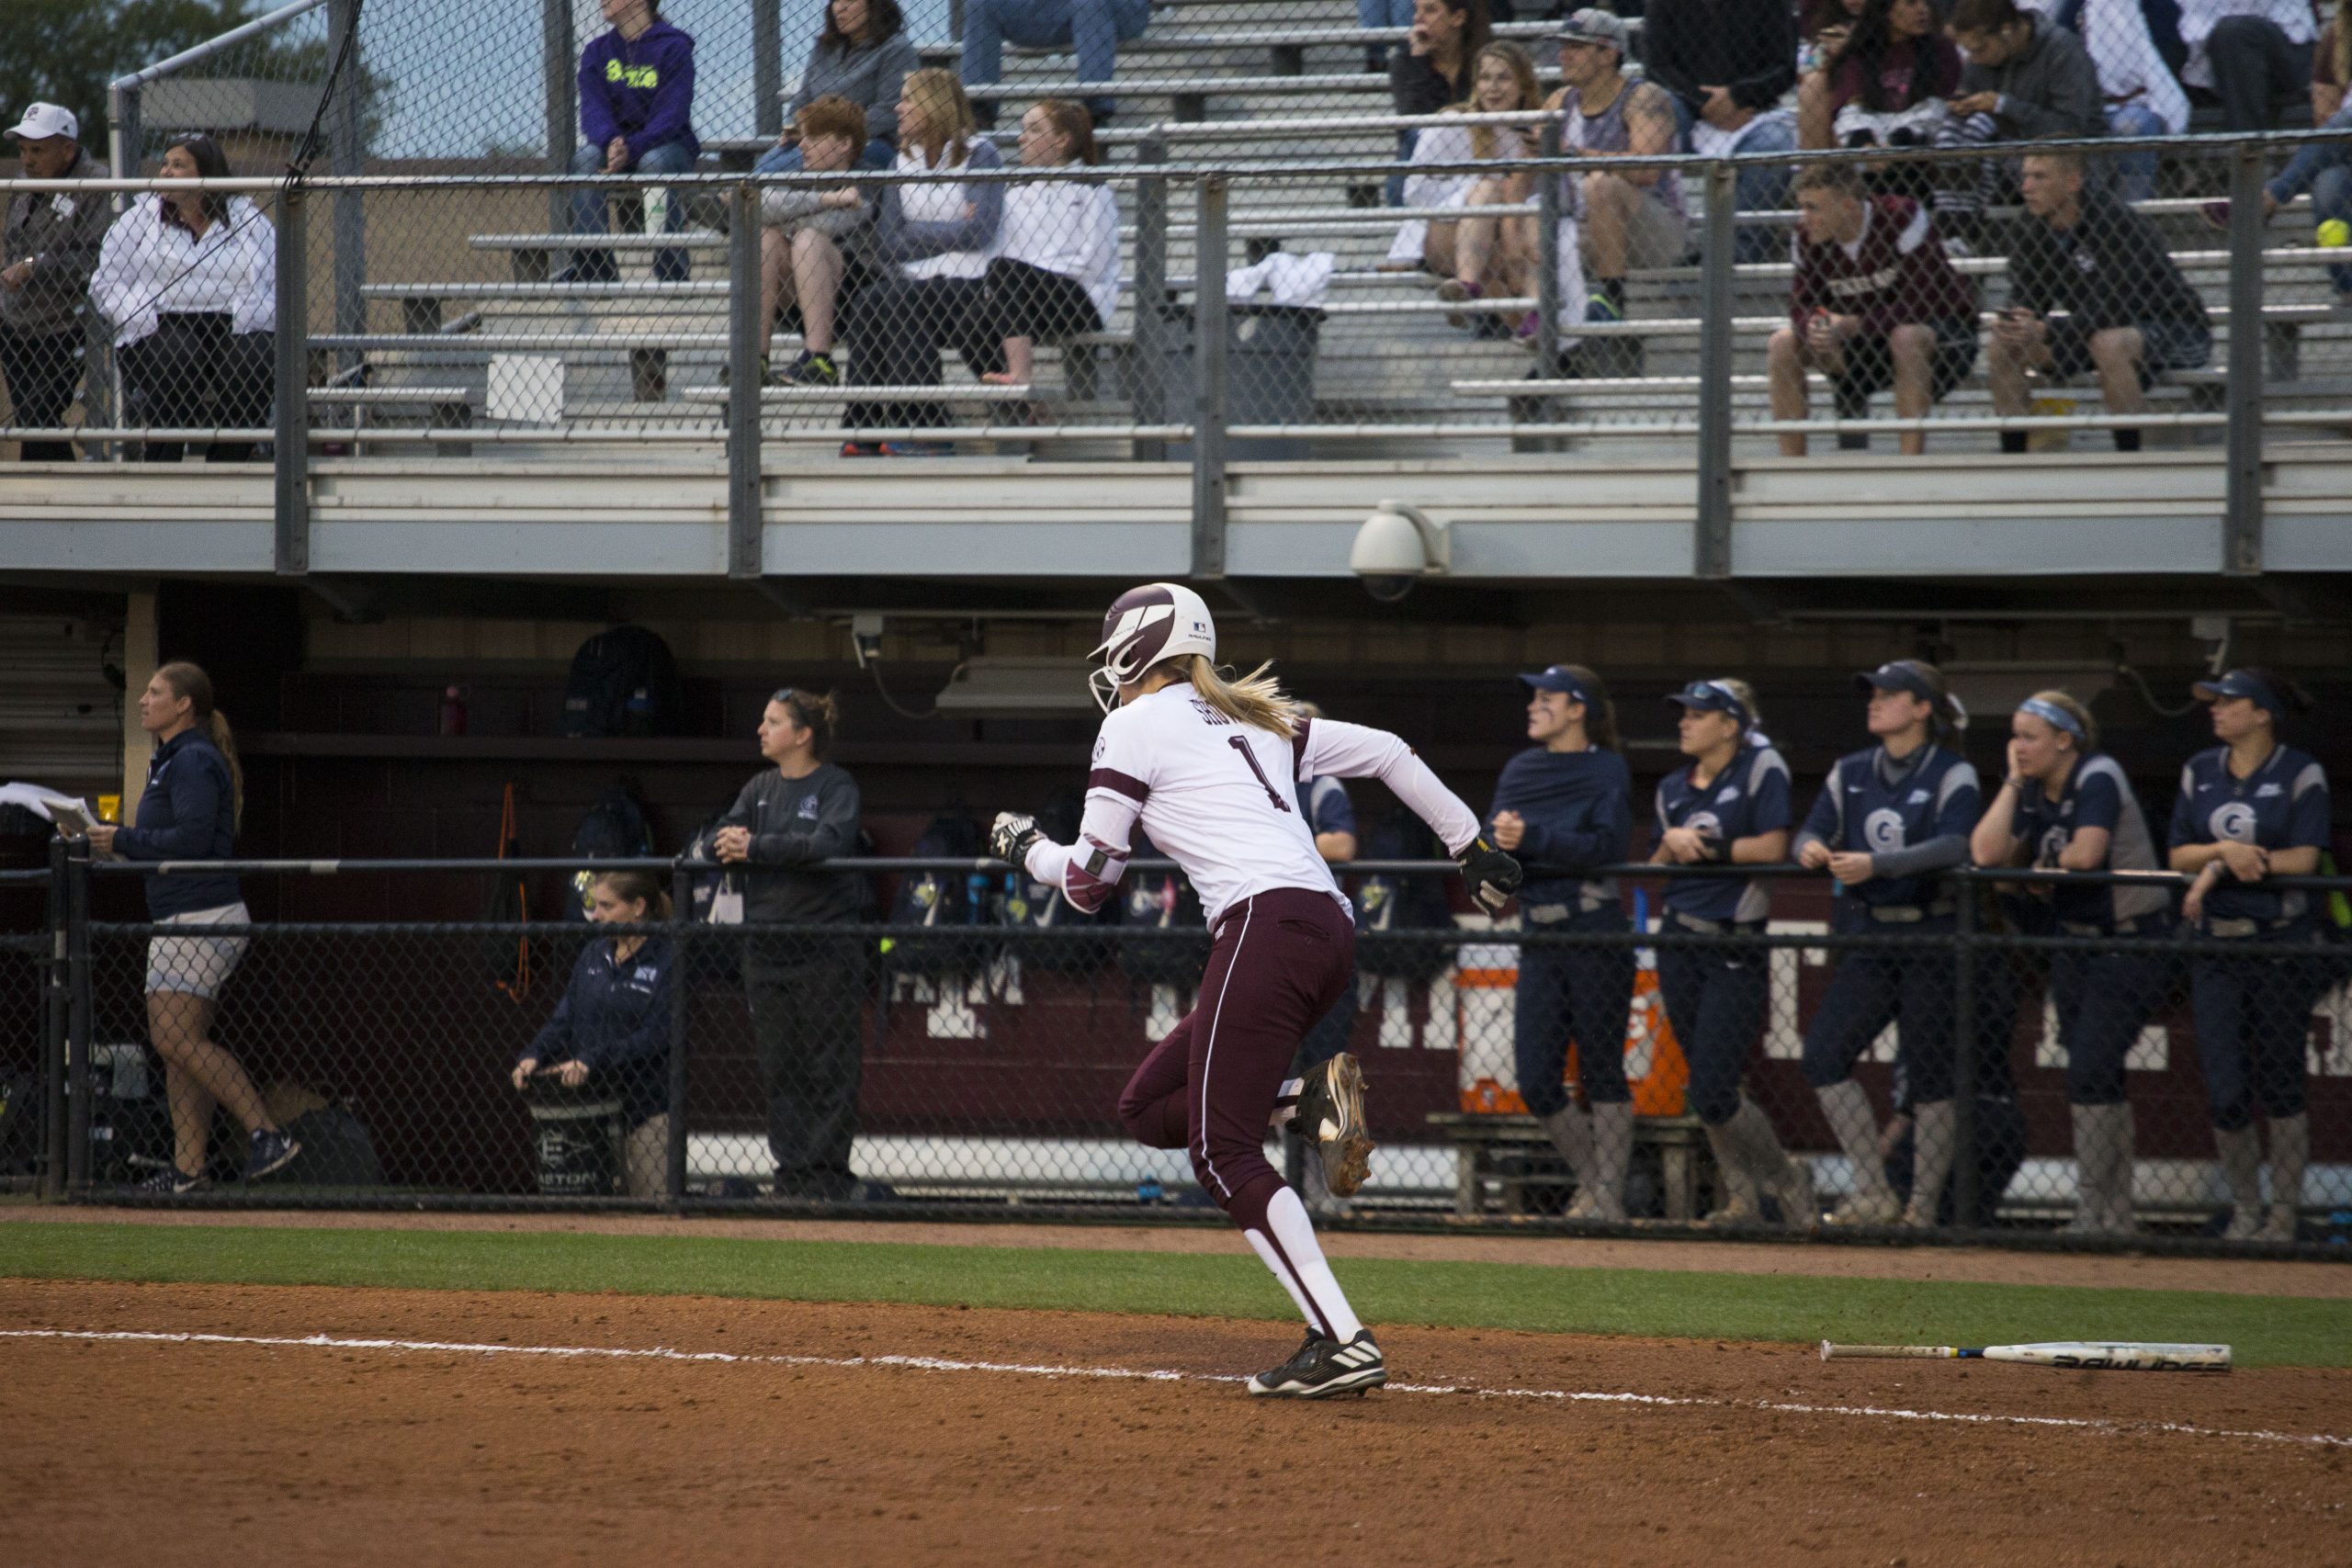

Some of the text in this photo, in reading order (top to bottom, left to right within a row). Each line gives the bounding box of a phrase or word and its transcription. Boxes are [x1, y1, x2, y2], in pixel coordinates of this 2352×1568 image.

[1227, 735, 1291, 813] 1
[1863, 807, 1905, 853] G
[2209, 801, 2257, 844] G
